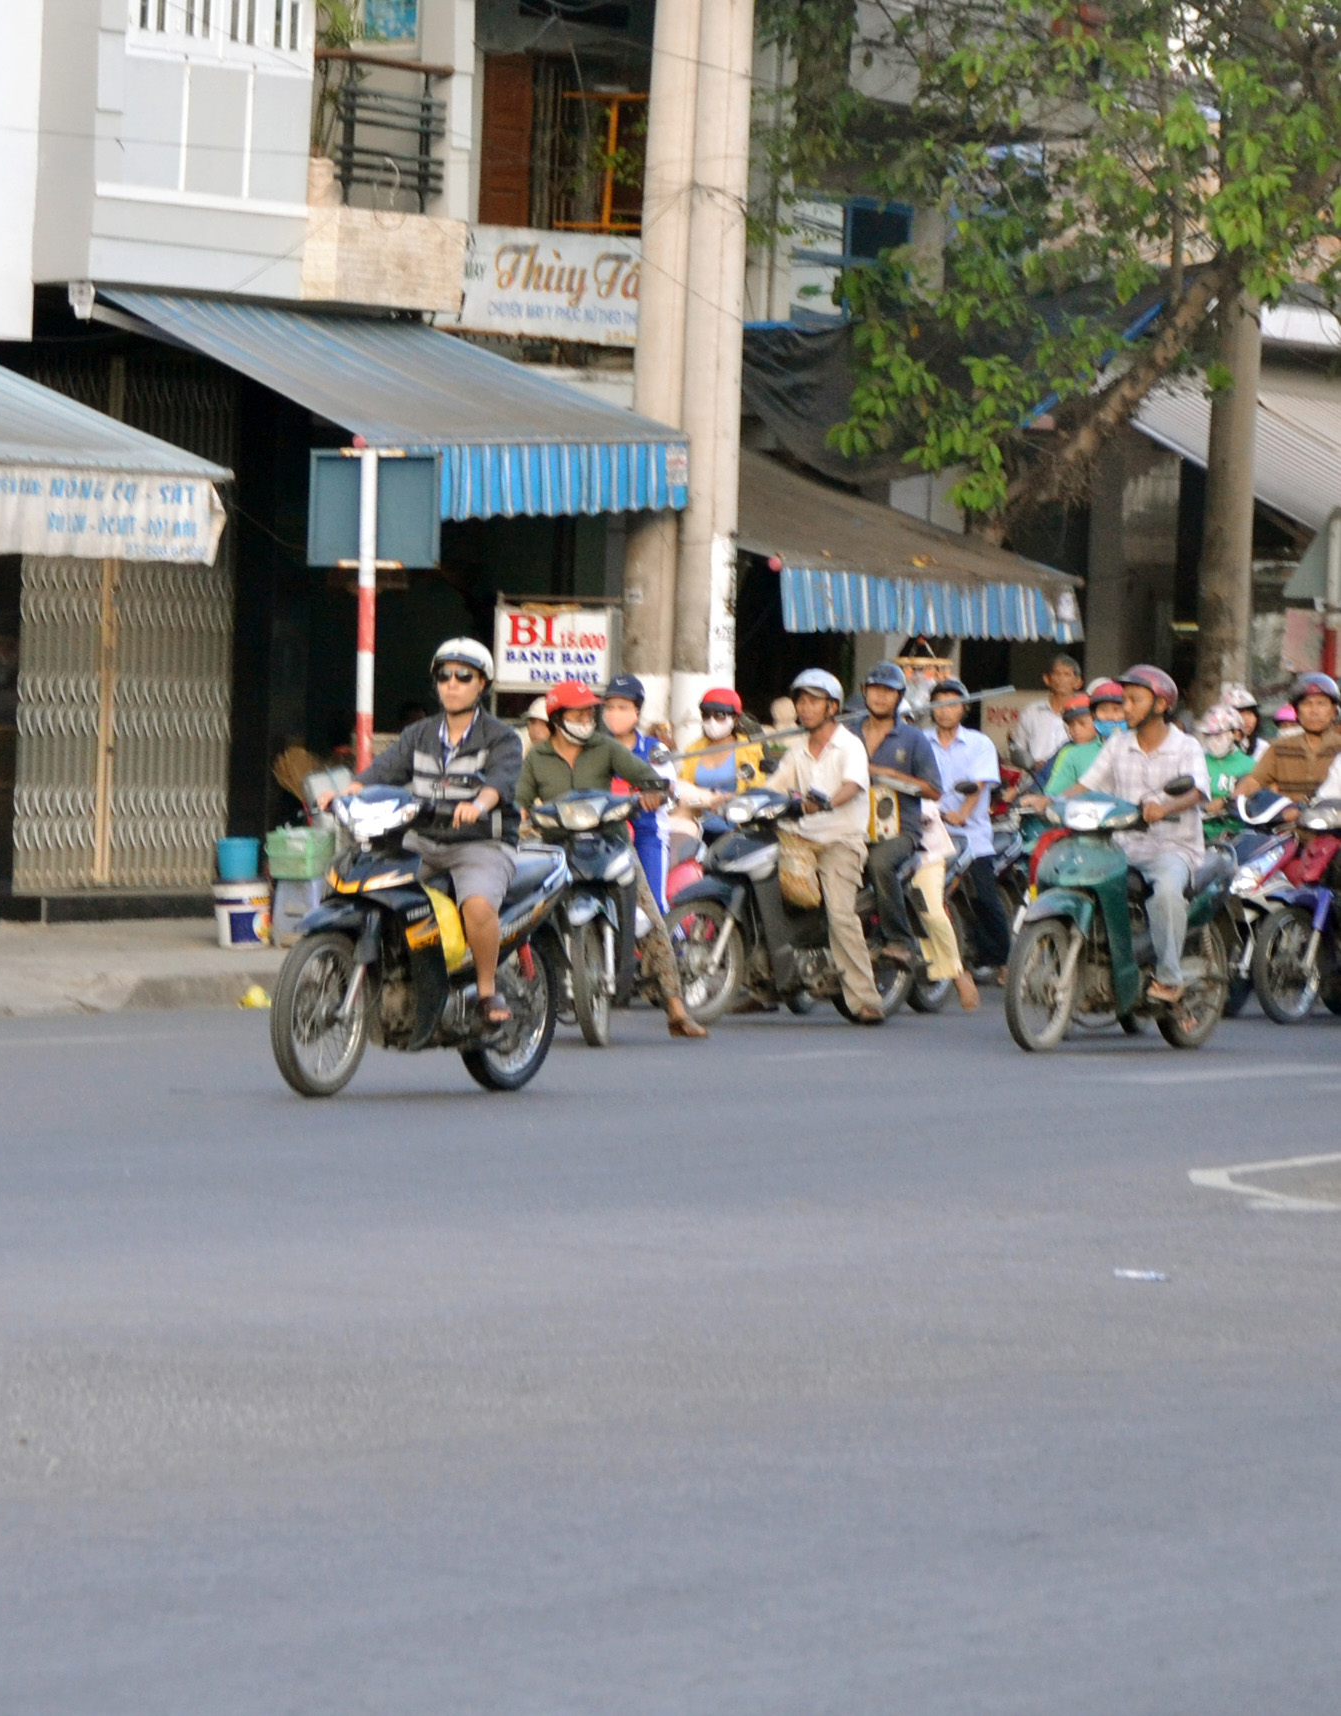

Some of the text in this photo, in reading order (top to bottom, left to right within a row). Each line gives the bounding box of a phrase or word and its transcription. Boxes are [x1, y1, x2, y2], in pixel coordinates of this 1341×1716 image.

[494, 243, 640, 307] Thùy Tâ
[50, 476, 105, 500] NÔNG
[506, 613, 558, 647] BI
[561, 652, 597, 666] BAO
